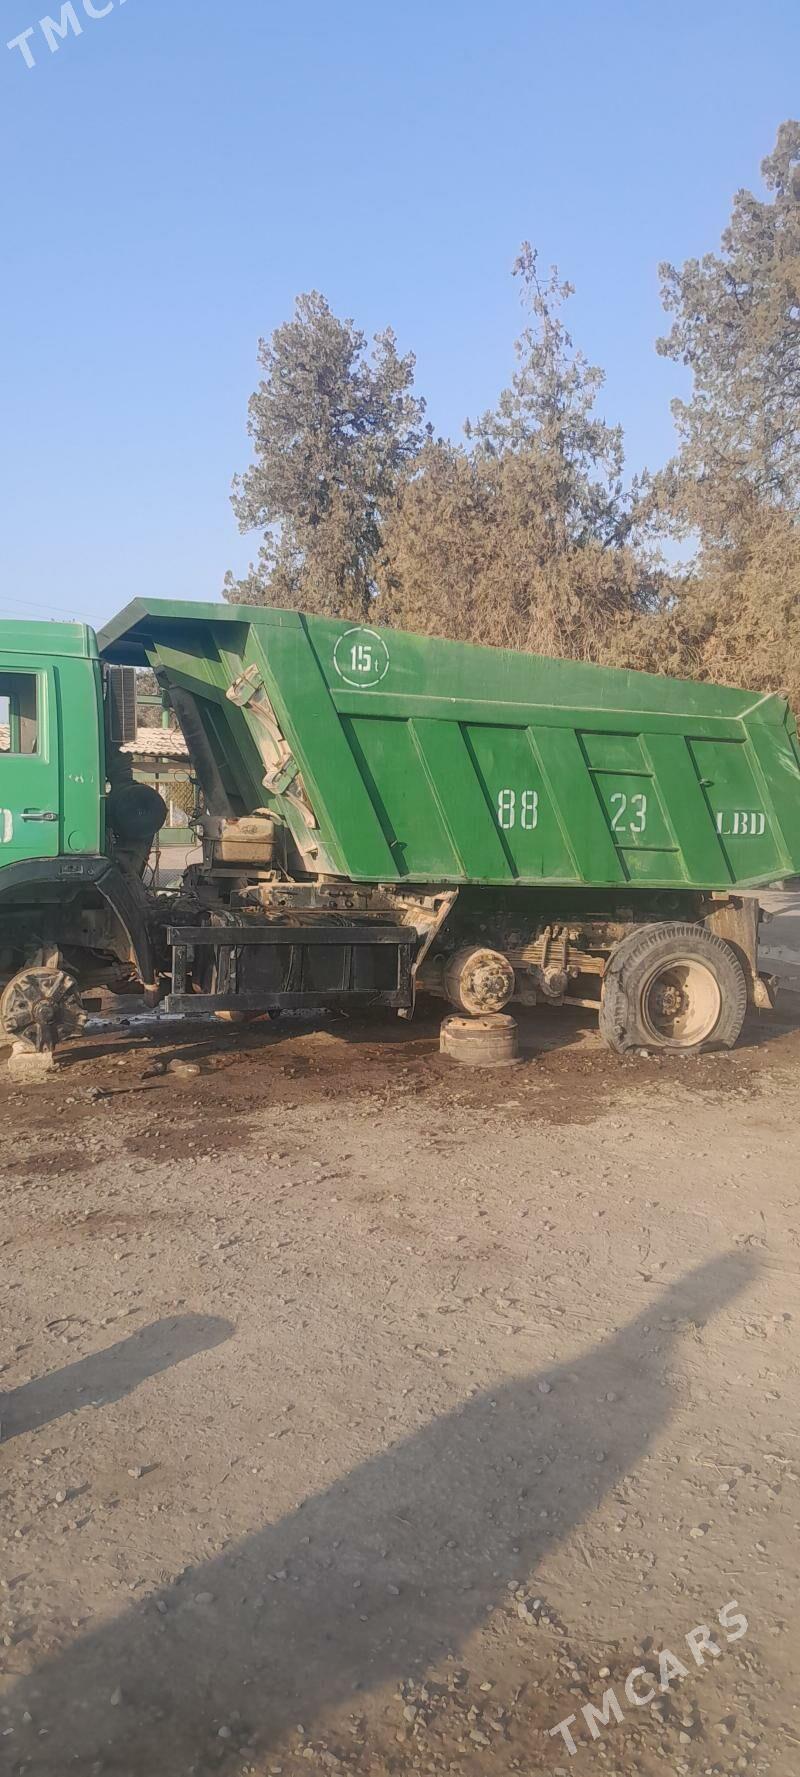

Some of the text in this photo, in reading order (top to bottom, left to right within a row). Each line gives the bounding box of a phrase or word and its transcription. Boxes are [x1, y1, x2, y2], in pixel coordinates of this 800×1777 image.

[498, 789, 766, 835] 88 23 LBD
